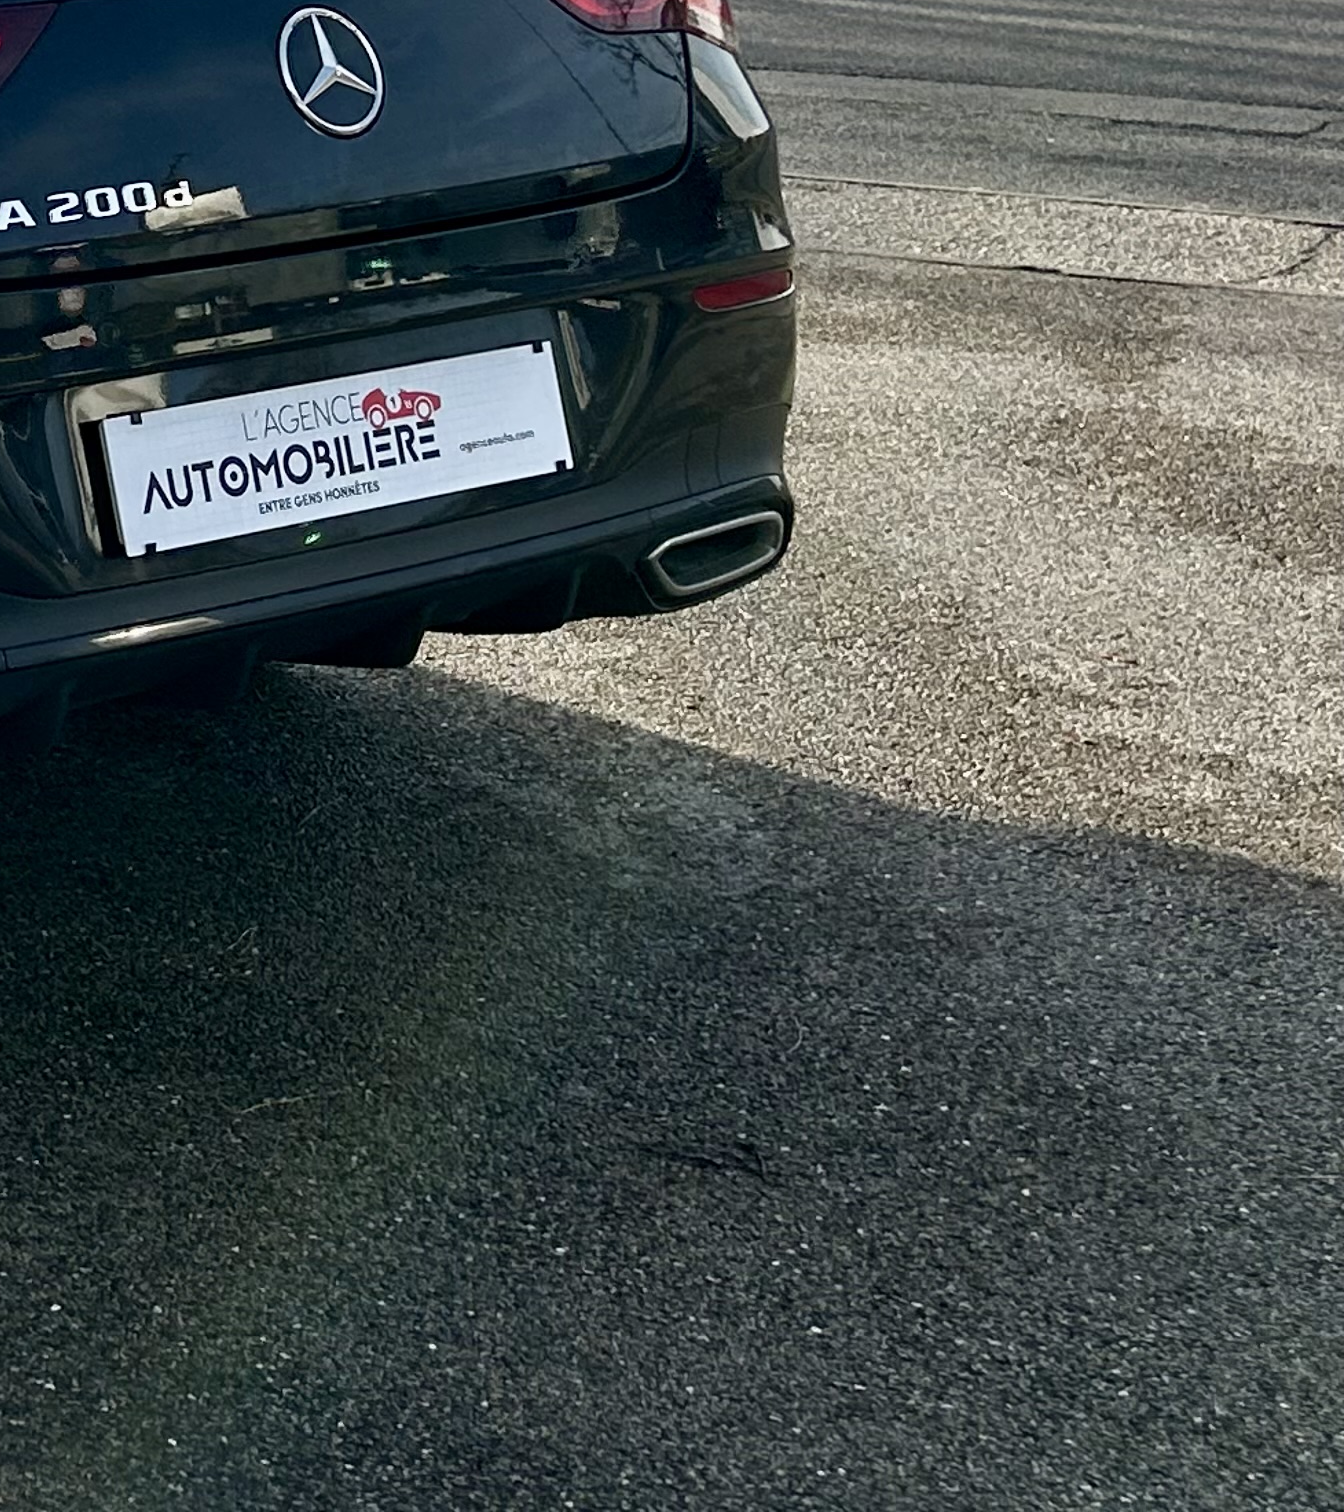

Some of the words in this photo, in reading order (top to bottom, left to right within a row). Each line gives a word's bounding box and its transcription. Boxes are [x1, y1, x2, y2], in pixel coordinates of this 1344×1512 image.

[240, 392, 365, 441] L'AGENCE
[258, 497, 292, 515] ENTRE
[294, 490, 323, 508] GENS
[324, 479, 381, 503] HONNÊTES
